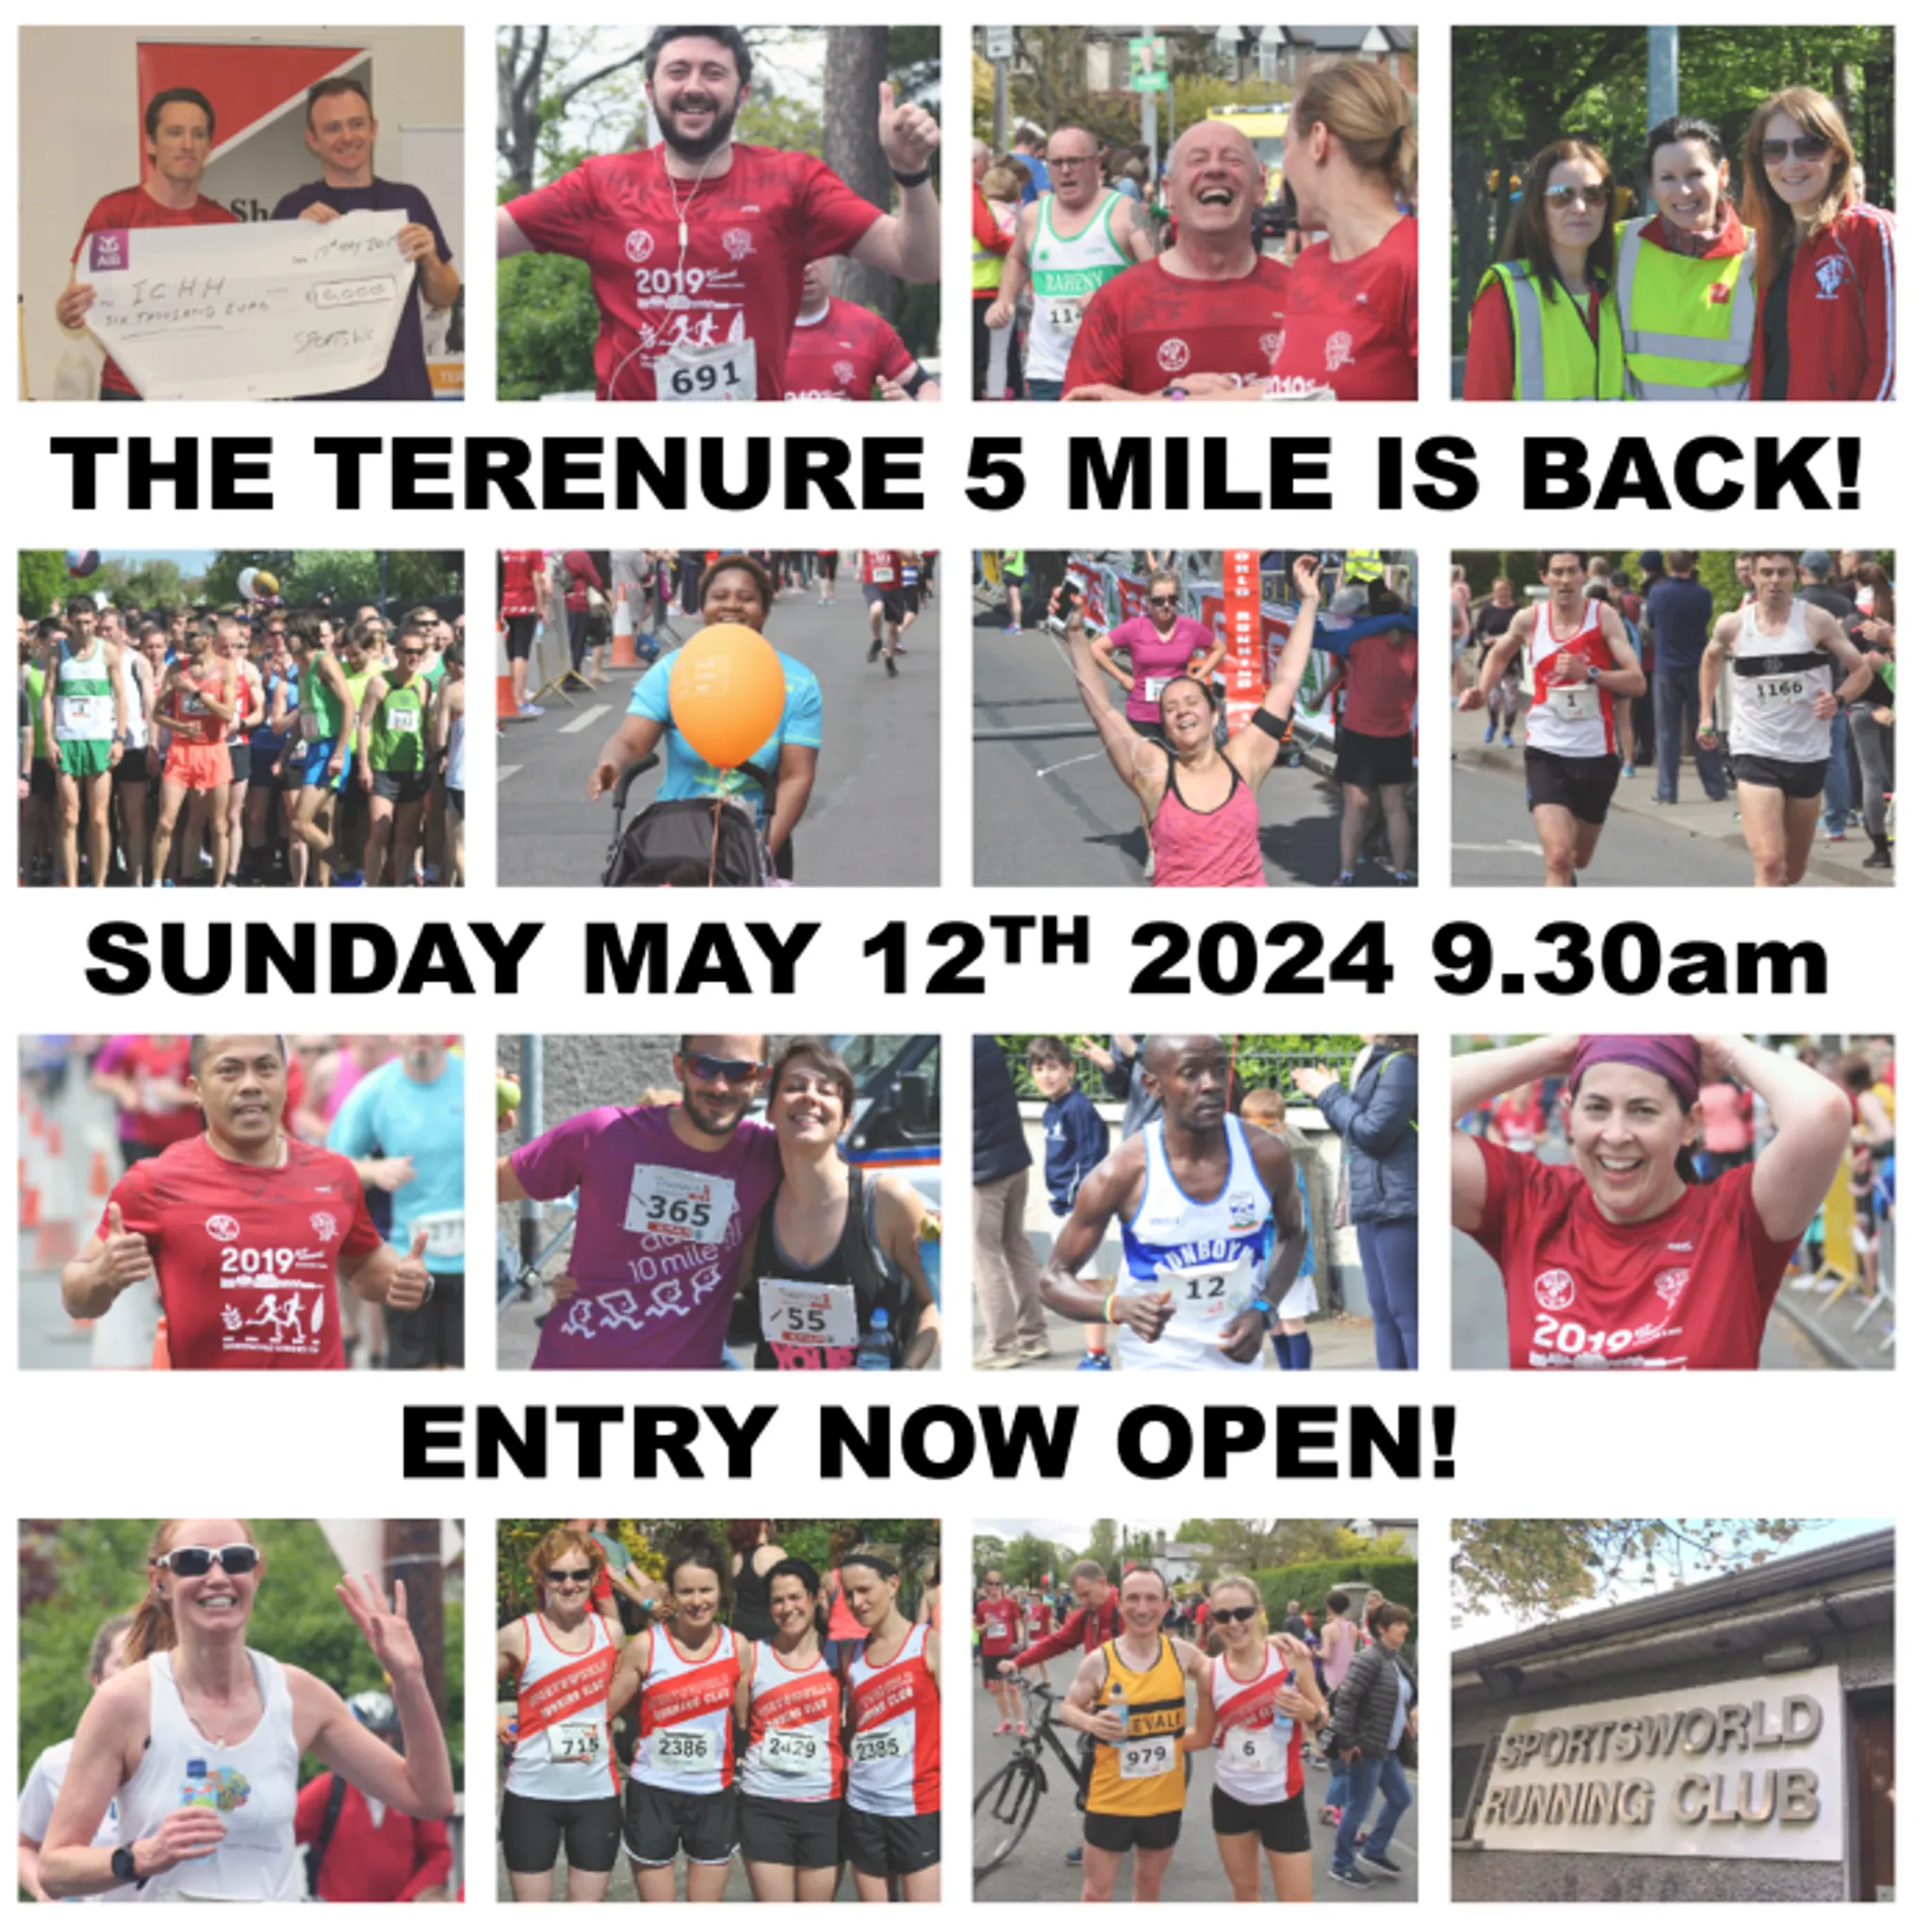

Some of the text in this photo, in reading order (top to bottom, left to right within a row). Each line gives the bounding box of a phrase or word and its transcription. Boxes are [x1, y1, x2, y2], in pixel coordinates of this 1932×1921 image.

[635, 268, 705, 293] 2019
[672, 360, 741, 395] 691
[1567, 693, 1577, 708] 1
[645, 1194, 712, 1228] 365
[221, 1247, 294, 1274] 2019
[661, 1244, 719, 1276] mile
[1186, 1275, 1226, 1300] 12
[788, 1307, 826, 1332] 55
[1533, 1313, 1632, 1353] 2019
[1499, 1694, 1824, 1770] SPORTSWORLD
[658, 1738, 708, 1758] 2386
[856, 1737, 901, 1762] 2385
[1127, 1746, 1167, 1766] 979
[1242, 1740, 1256, 1758] 6
[1482, 1766, 1821, 1827] RUNNING CLUB
